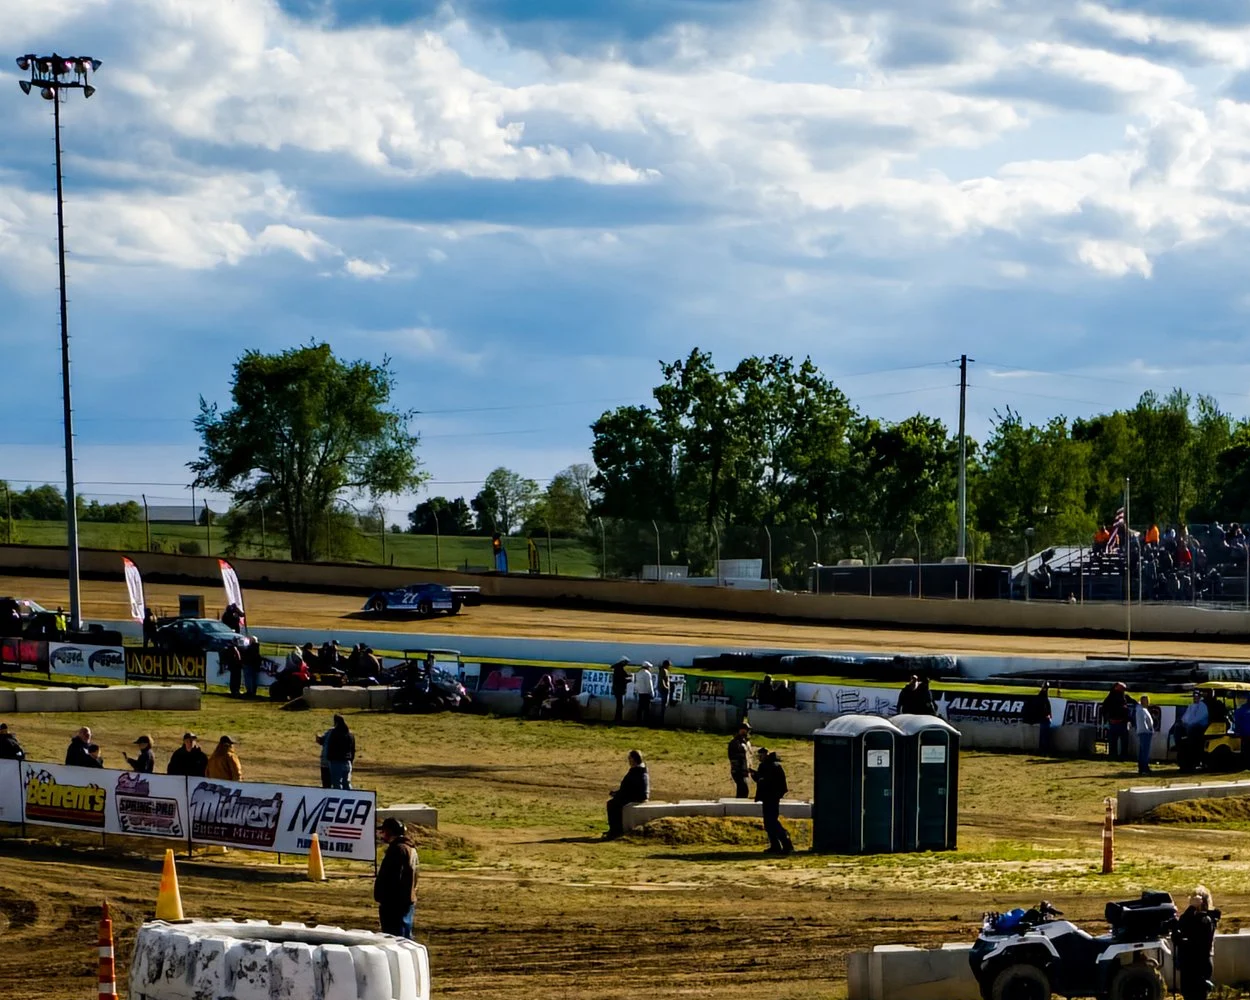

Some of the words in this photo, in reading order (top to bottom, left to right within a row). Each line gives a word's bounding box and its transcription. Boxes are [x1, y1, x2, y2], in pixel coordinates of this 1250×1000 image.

[402, 593, 419, 604] 21
[126, 651, 163, 675] UNOH
[166, 652, 205, 677] UNOH
[948, 697, 1025, 714] ALLSTAR
[27, 777, 105, 811] Behrent's
[191, 783, 283, 829] Midwest
[287, 795, 373, 834] MEGA
[193, 822, 228, 836] SHEET
[232, 827, 272, 841] METAL
